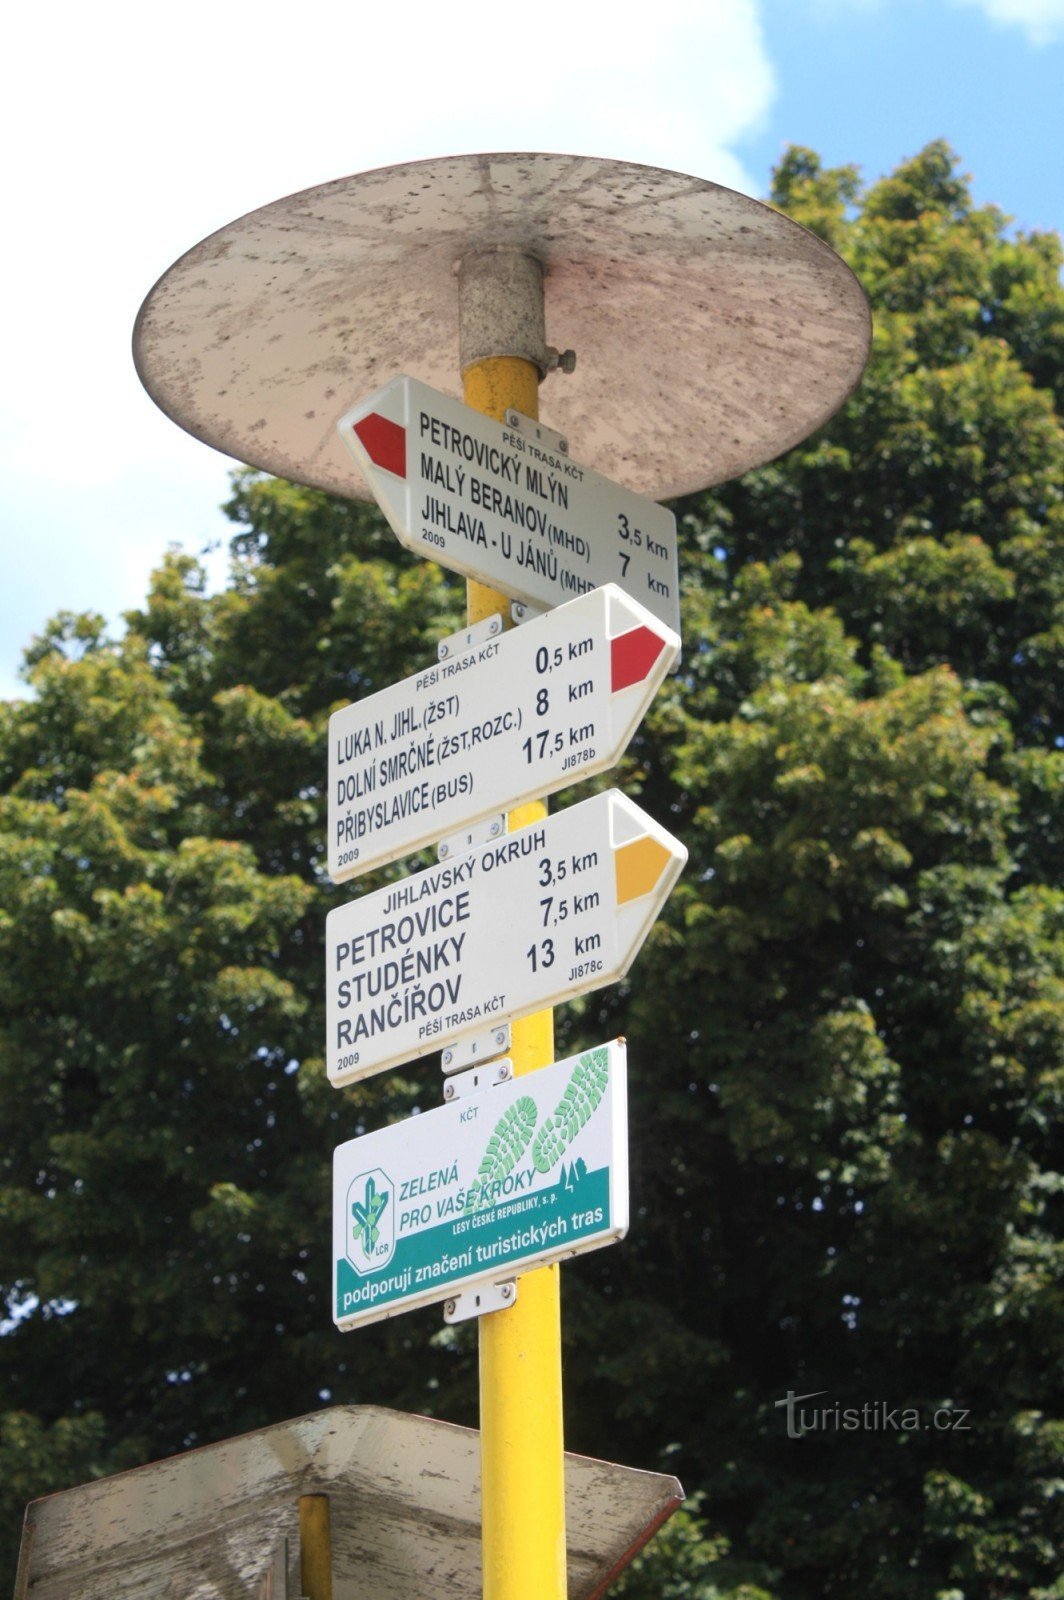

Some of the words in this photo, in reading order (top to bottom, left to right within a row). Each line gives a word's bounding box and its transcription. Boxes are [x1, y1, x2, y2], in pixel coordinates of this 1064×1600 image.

[420, 411, 521, 485] PETROVICKÝ
[526, 465, 569, 510] MLÝN
[421, 452, 466, 497] MALÝ
[502, 431, 526, 453] PĚŠÍ
[528, 444, 563, 472] TRASA
[564, 465, 585, 482] KČT
[421, 494, 488, 549] JIHLAVA
[501, 531, 511, 559] U
[422, 528, 446, 548] 2009
[618, 513, 642, 547] 3,5
[646, 534, 669, 560] km
[618, 552, 631, 577] 7
[647, 572, 670, 598] km
[416, 670, 440, 692] PĚŠÍ
[442, 654, 477, 679] TRASA
[479, 643, 500, 663] KČT
[535, 646, 563, 673] 0,5
[568, 637, 594, 661] km
[536, 688, 549, 716] 8
[568, 680, 594, 702] km
[337, 726, 372, 765] LUKA
[375, 720, 387, 749] N.
[522, 730, 564, 764] 17,5
[569, 723, 595, 746] km
[337, 758, 376, 806] DOLNÍ
[337, 848, 359, 867] 2009
[383, 858, 476, 915] JIHLAVSKÝ
[481, 829, 546, 872] OKRUH
[539, 858, 567, 887] 3,5
[572, 851, 598, 874] km
[336, 891, 471, 971] PETROVICE
[540, 896, 568, 927] 7,5
[573, 892, 600, 915] km
[337, 932, 466, 1009] STUDÉNKY
[527, 938, 555, 973] 13
[575, 933, 601, 956] km
[337, 974, 462, 1049] RANČÍŘOV
[418, 1017, 442, 1039] PĚŠÍ
[445, 1007, 481, 1029] TRASA
[484, 995, 506, 1014] KČT
[337, 1052, 359, 1070] 2009
[460, 1107, 479, 1123] KČT
[399, 1159, 459, 1202] ZELENÁ
[400, 1203, 432, 1231] PRO
[437, 1187, 477, 1219] VAŠE
[479, 1167, 537, 1201] KROKY
[452, 1219, 470, 1235] LESY
[472, 1209, 496, 1229] ČESKÉ
[497, 1195, 541, 1220] REPUBLIKY,
[343, 1266, 412, 1310] podporují
[415, 1247, 472, 1283] značení
[476, 1216, 567, 1262] turistických
[571, 1207, 603, 1229] tras
